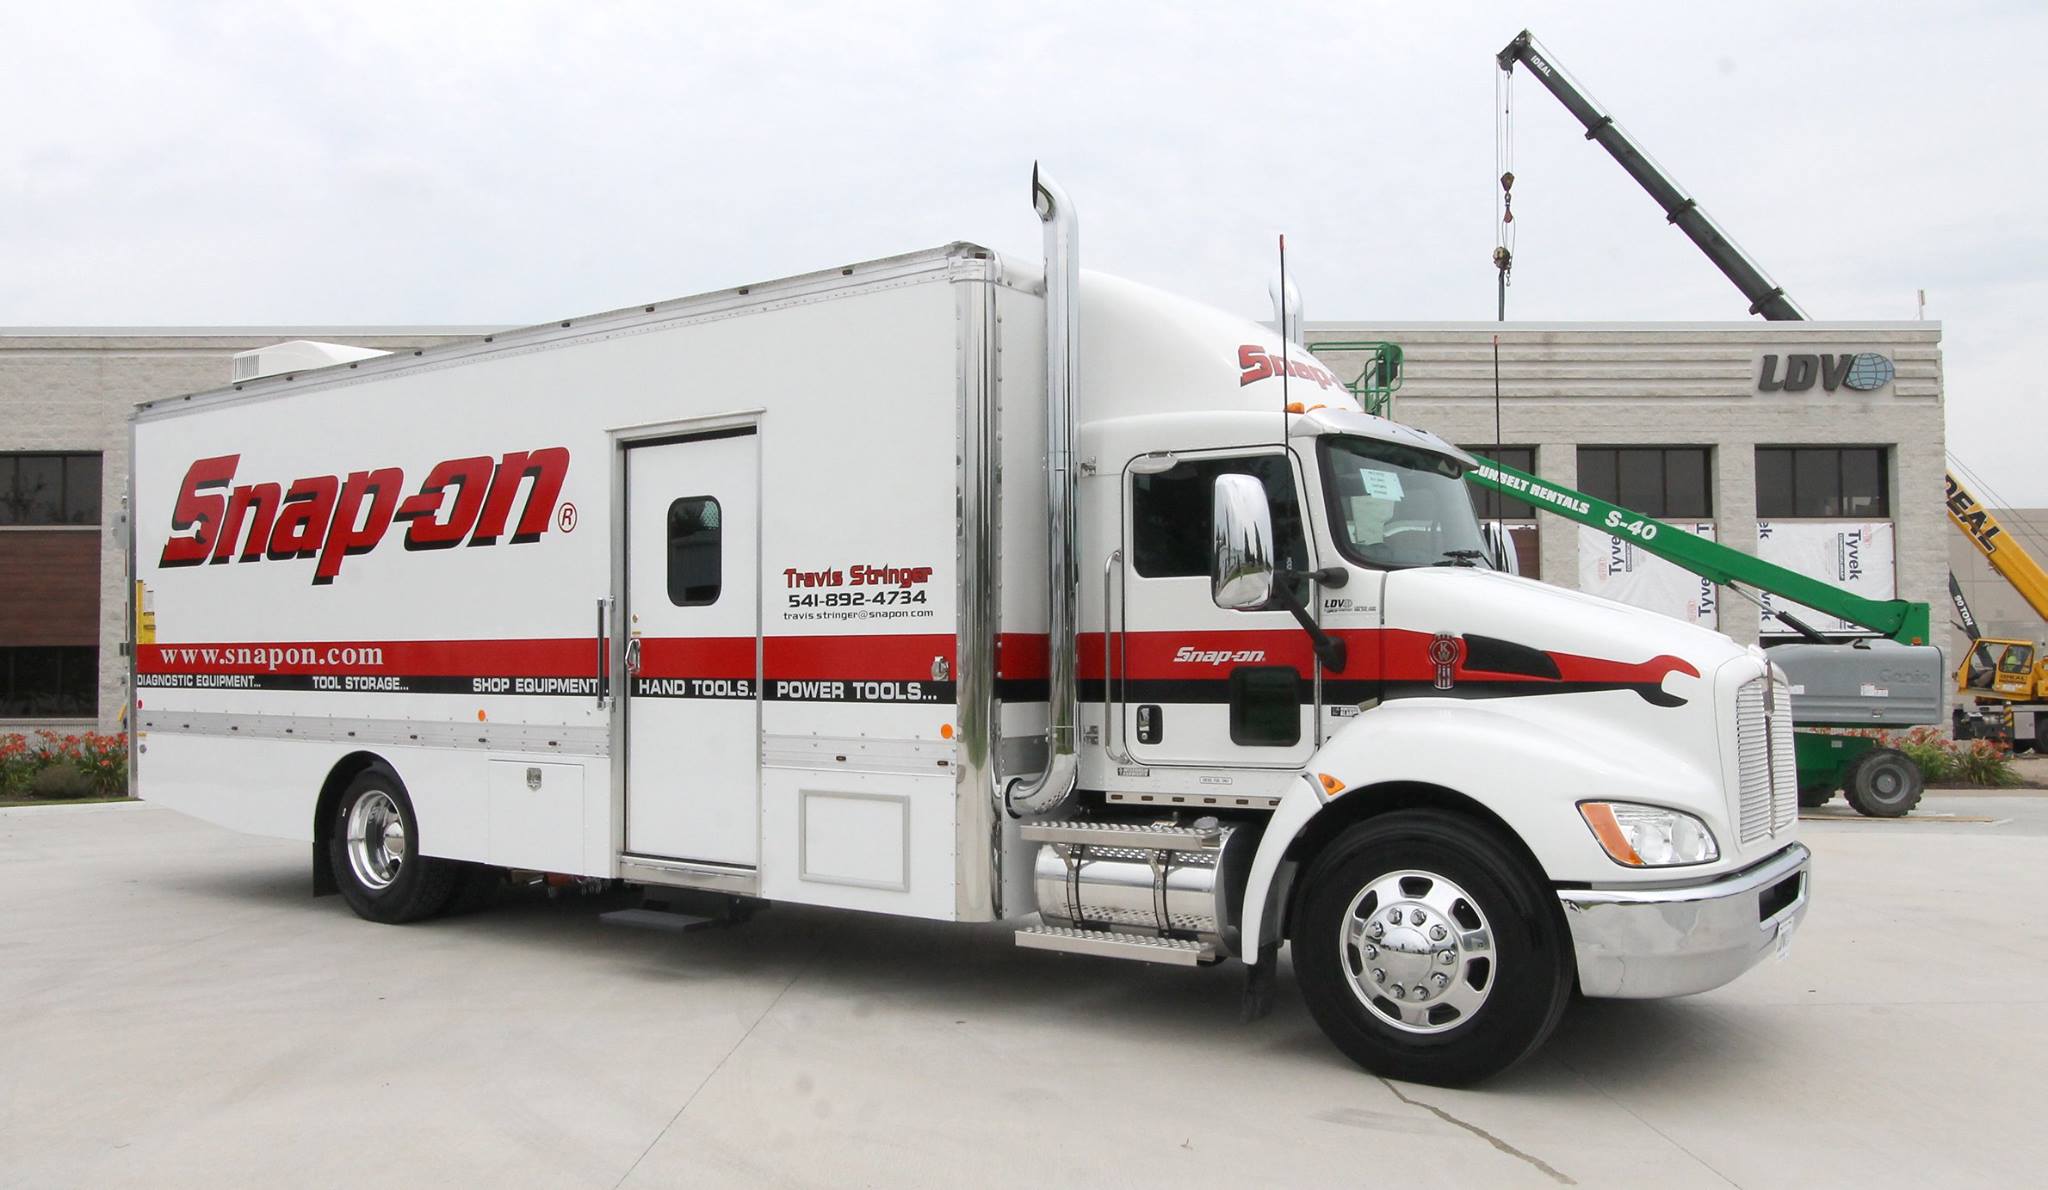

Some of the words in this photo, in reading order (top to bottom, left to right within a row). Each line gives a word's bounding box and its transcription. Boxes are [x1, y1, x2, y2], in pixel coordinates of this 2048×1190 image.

[1530, 54, 1552, 77] IDEAL
[1758, 353, 1853, 392] LDV
[1470, 464, 1530, 492] UNBELT
[1529, 483, 1590, 515] RENTALS
[1605, 511, 1657, 540] S-40
[1846, 529, 1862, 580] Tyvek
[783, 566, 843, 588] Travis
[850, 563, 933, 588] Stringer
[788, 590, 927, 608] 541-892-4734
[1324, 599, 1346, 608] LDV
[1960, 607, 1973, 626] TON
[160, 647, 384, 671] www.snapon.com
[1173, 646, 1265, 666] Snap-on
[136, 674, 193, 686] DIAGNOSTIC
[312, 676, 341, 689] TOOL
[472, 678, 510, 692] SHOP
[639, 679, 686, 695] HAND
[777, 681, 844, 699] POWER
